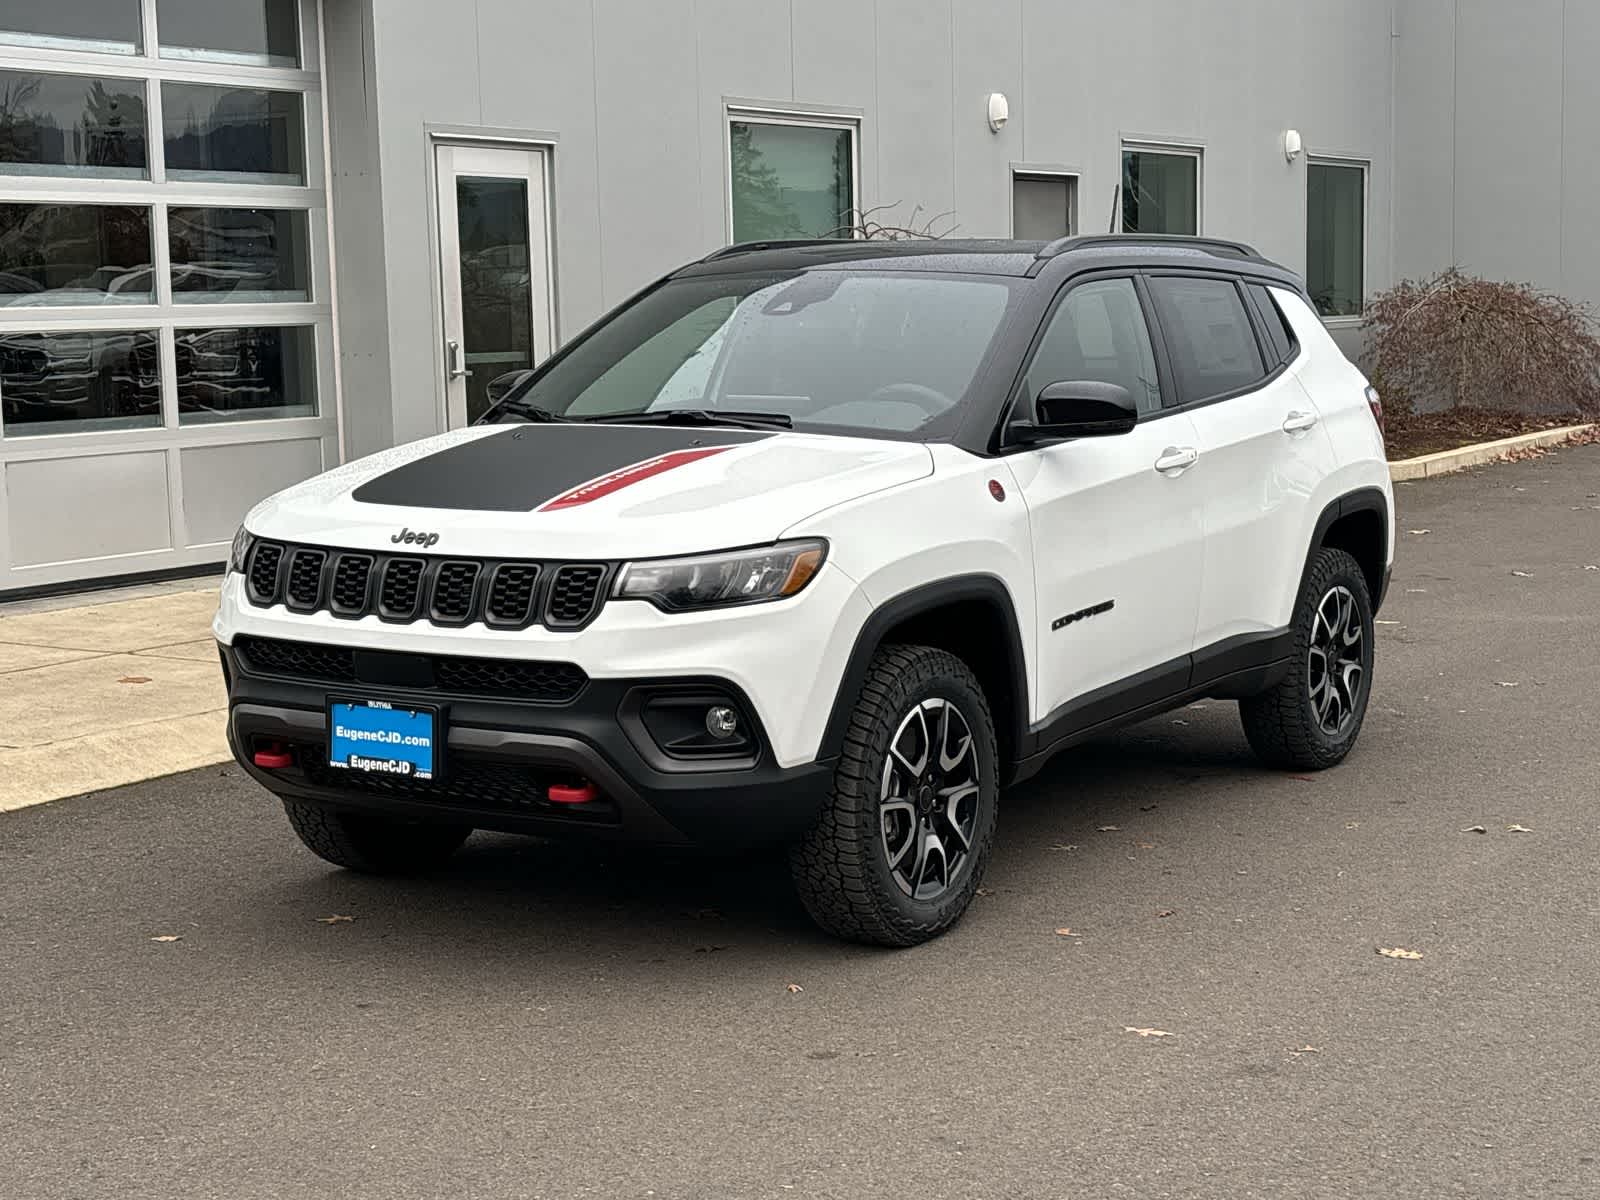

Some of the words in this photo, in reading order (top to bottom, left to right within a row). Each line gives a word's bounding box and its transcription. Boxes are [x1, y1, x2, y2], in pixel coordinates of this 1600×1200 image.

[391, 527, 440, 549] Jeep
[336, 725, 430, 747] EugeneCJD.com
[350, 755, 410, 774] EugeneCJD
